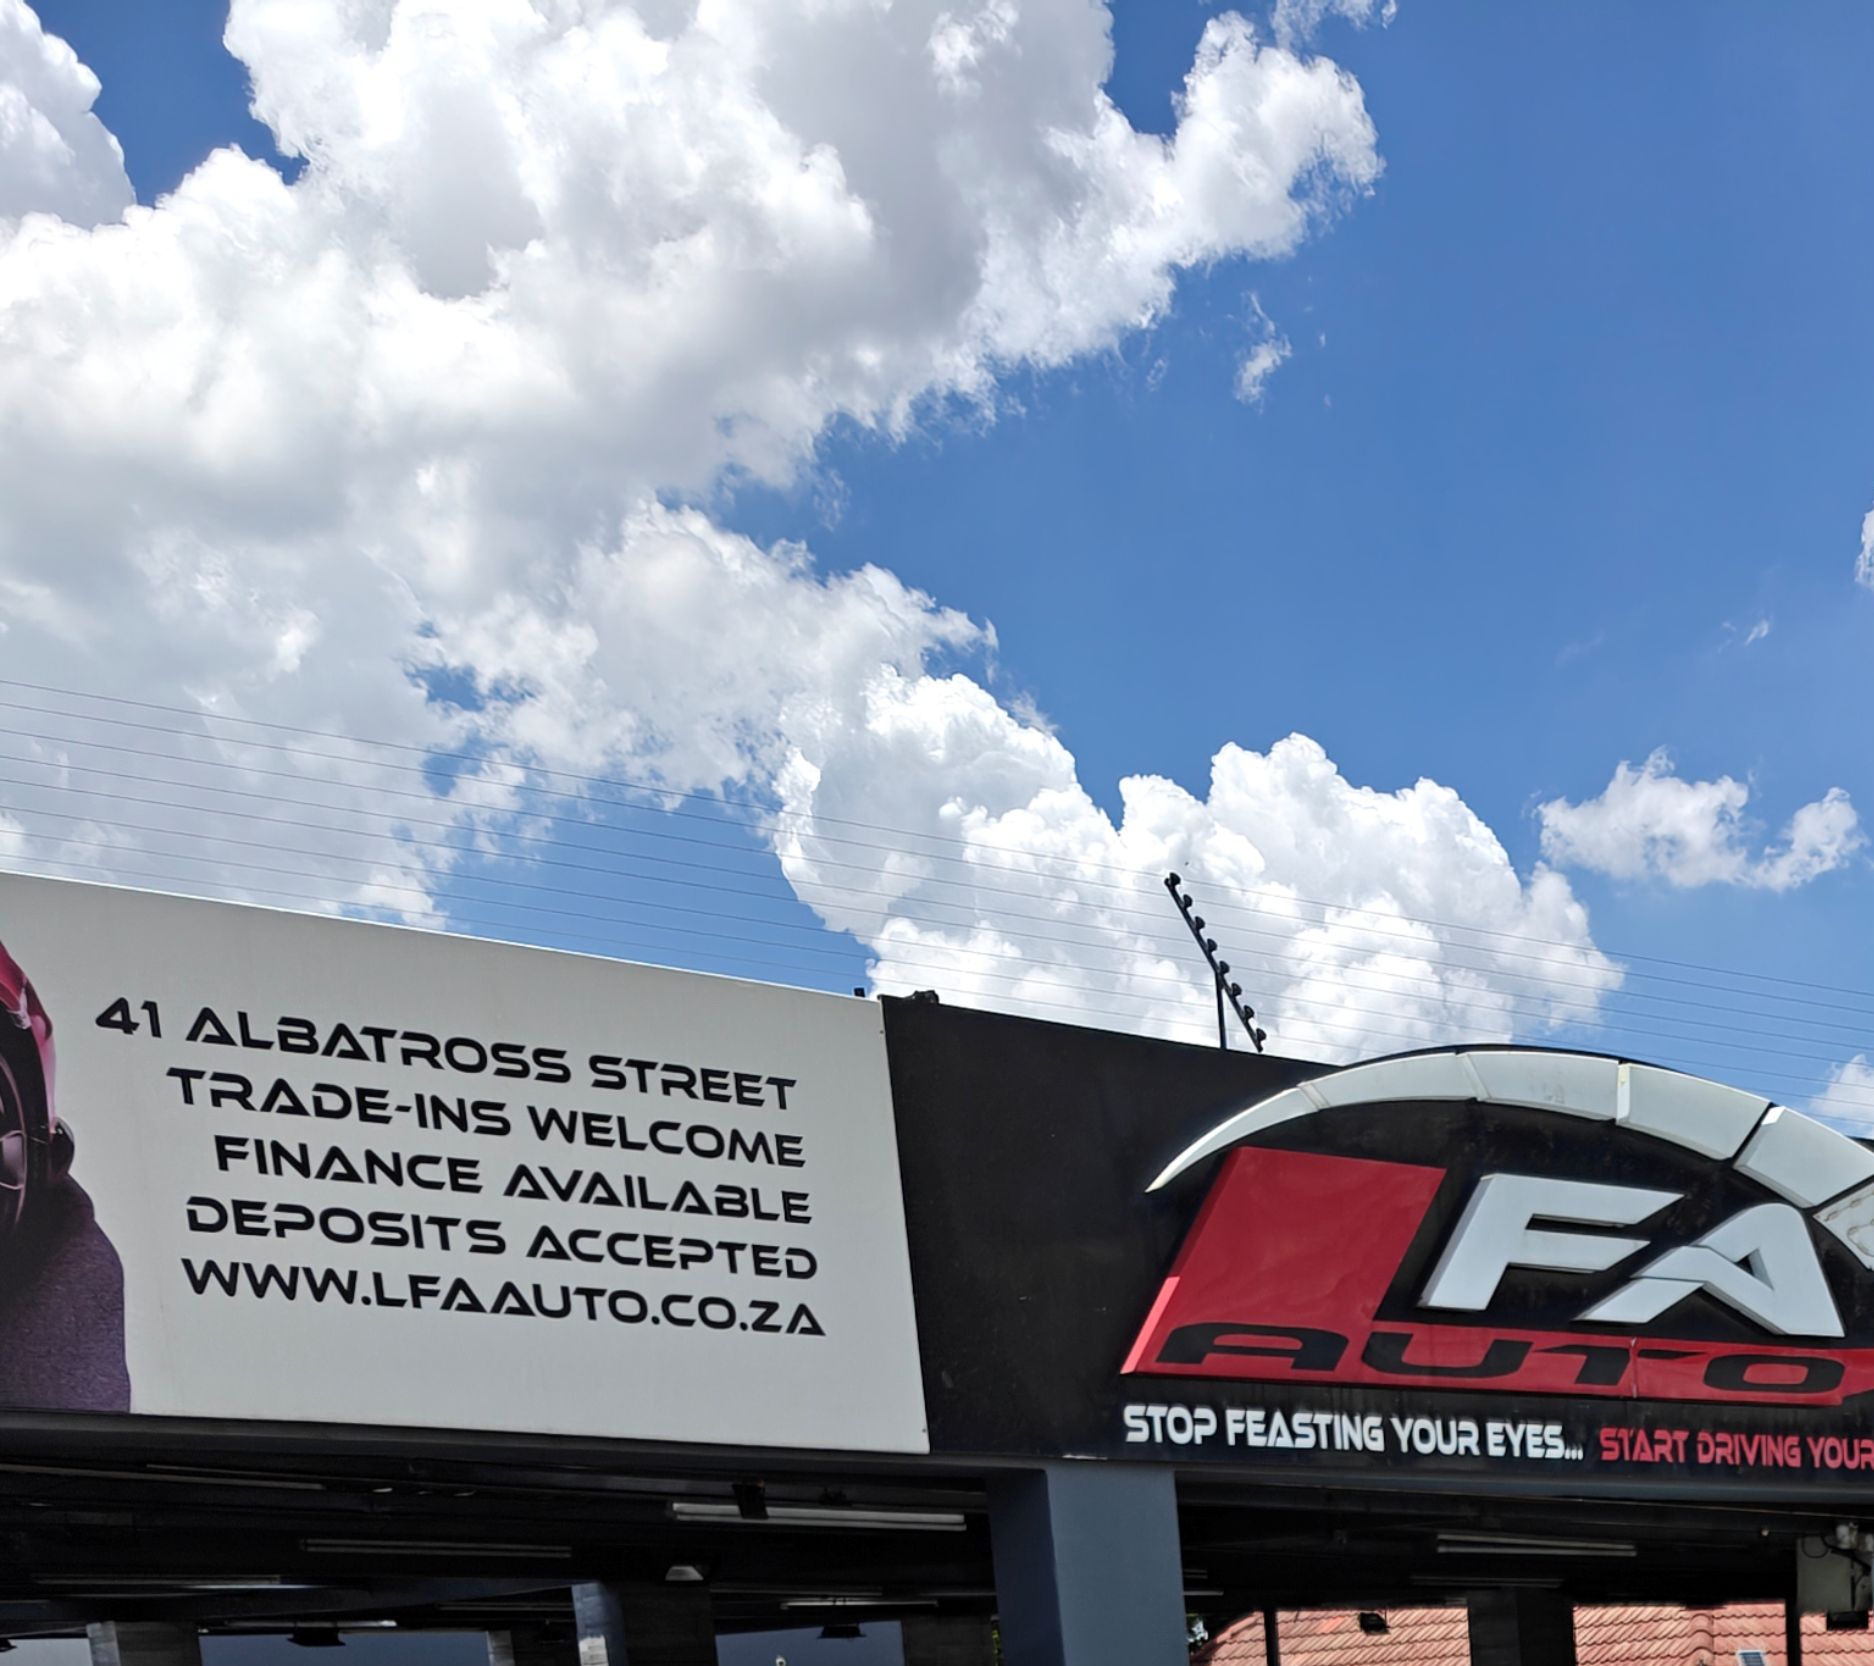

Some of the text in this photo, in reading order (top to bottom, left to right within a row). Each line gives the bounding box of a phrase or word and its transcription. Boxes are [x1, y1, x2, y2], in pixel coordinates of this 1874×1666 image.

[96, 998, 796, 1110] 41 ALBATROSS STREET
[167, 1068, 805, 1167] TRADE-INS WELCOME
[215, 1135, 812, 1224] FINANCE AVAILABLE
[187, 1197, 817, 1279] DEPOSITS ACCEPTED
[182, 1258, 826, 1336] WWW.LFAAUTO.CO.ZA
[1155, 1322, 1846, 1394] AUTO
[1124, 1405, 1583, 1459] STOP FEASTING YOUR EYES...
[1600, 1428, 1689, 1462] START
[1697, 1431, 1801, 1467] DRIVING
